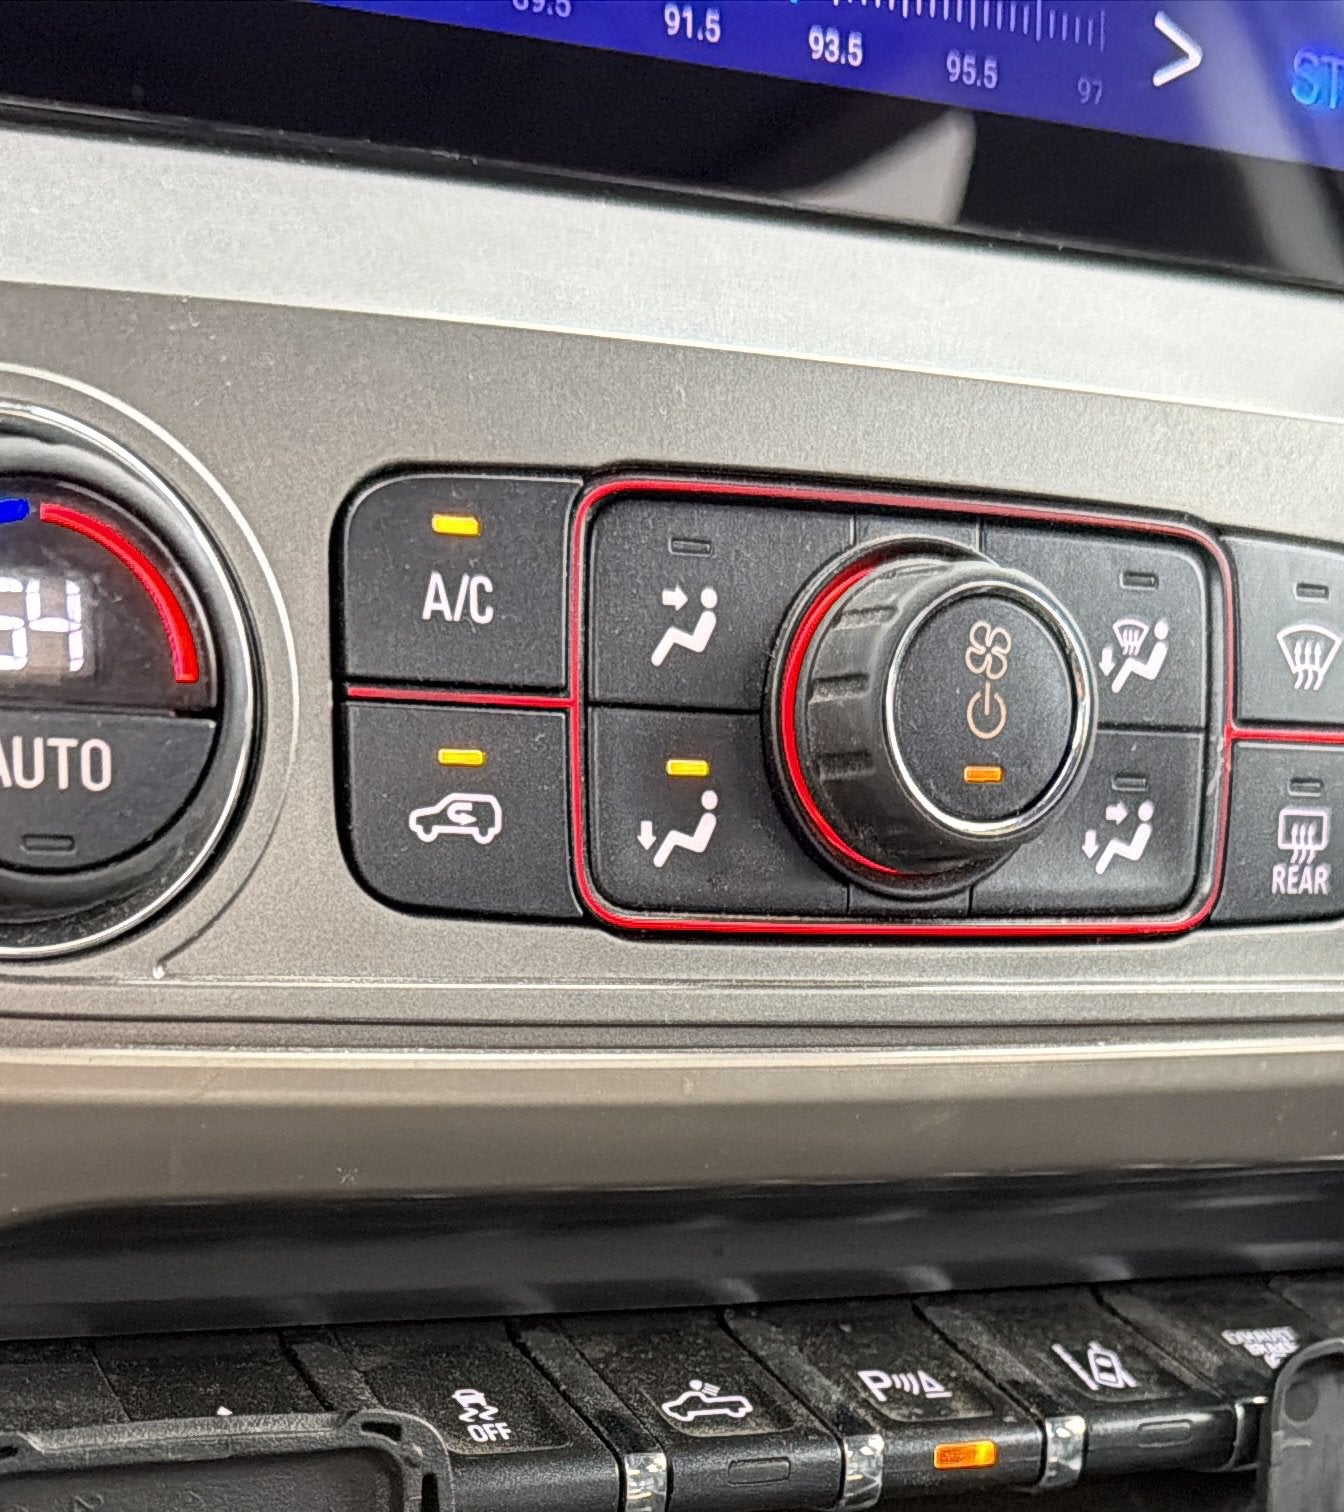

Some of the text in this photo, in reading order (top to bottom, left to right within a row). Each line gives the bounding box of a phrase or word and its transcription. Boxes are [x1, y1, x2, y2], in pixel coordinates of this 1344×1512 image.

[664, 3, 721, 43] 91.5
[808, 25, 863, 67] 93.5
[946, 51, 998, 89] 95.5
[1077, 78, 1103, 105] 97
[422, 572, 494, 624] A/C
[1271, 863, 1330, 895] REAR
[467, 1422, 512, 1443] OFF
